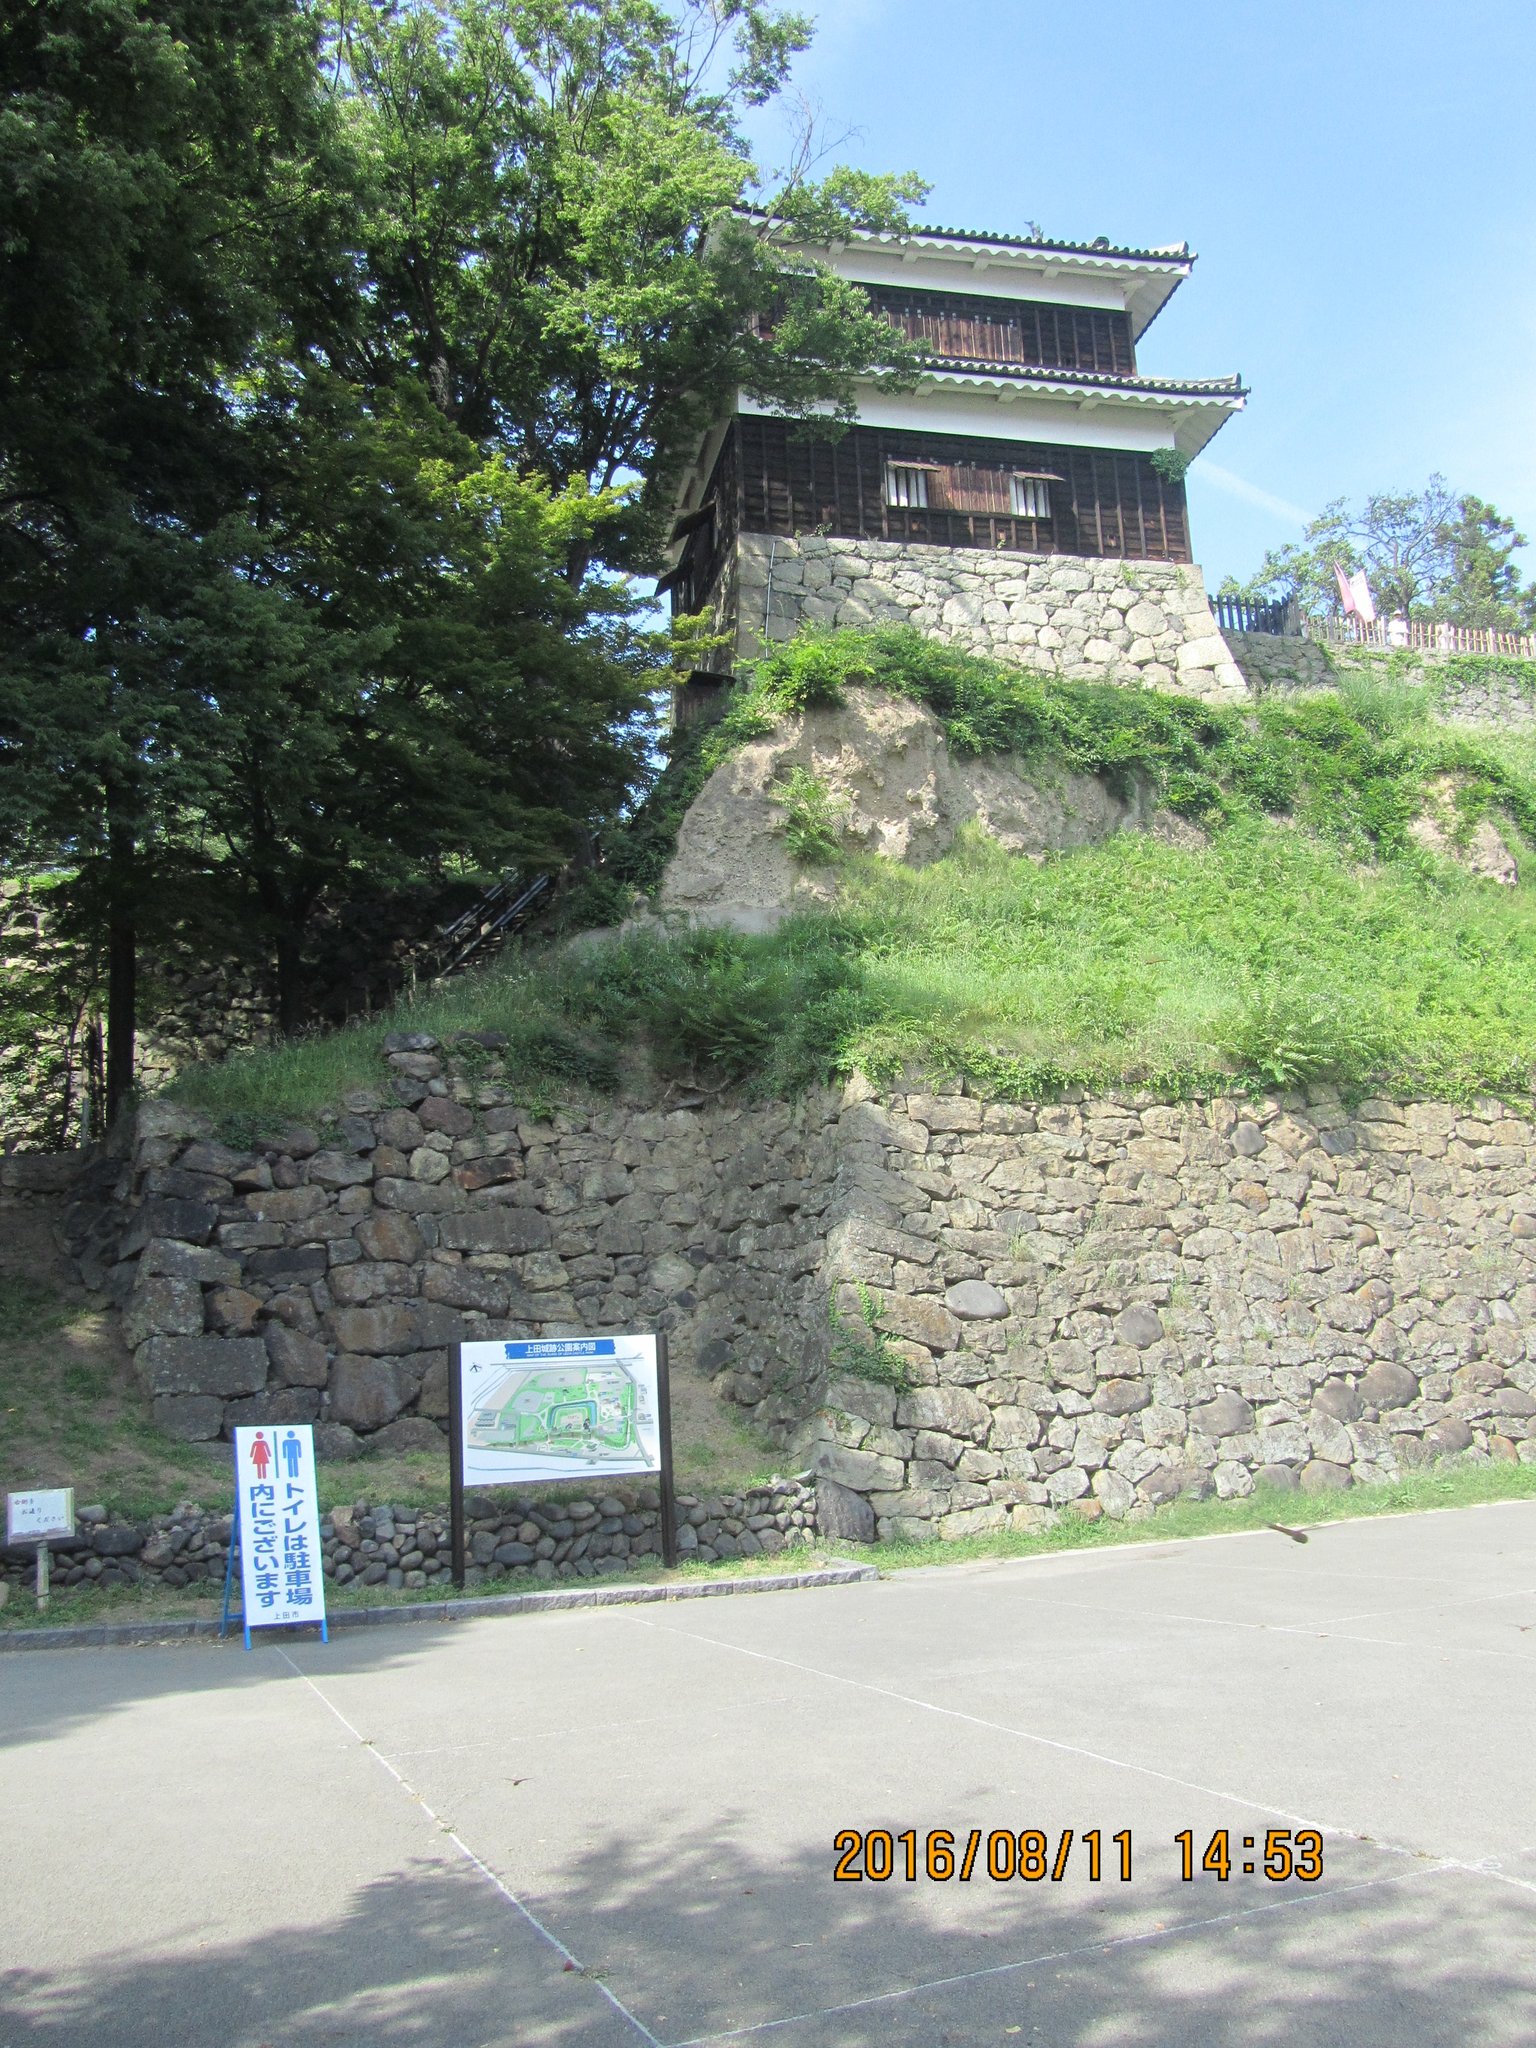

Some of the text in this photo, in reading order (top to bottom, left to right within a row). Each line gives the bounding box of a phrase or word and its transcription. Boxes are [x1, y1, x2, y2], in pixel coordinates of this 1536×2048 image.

[525, 1342, 596, 1354] 上田城跡公園案内図
[249, 1483, 281, 1608] 内にございます
[282, 1482, 313, 1606] トイレは駐車場
[273, 1611, 300, 1620] 上田市
